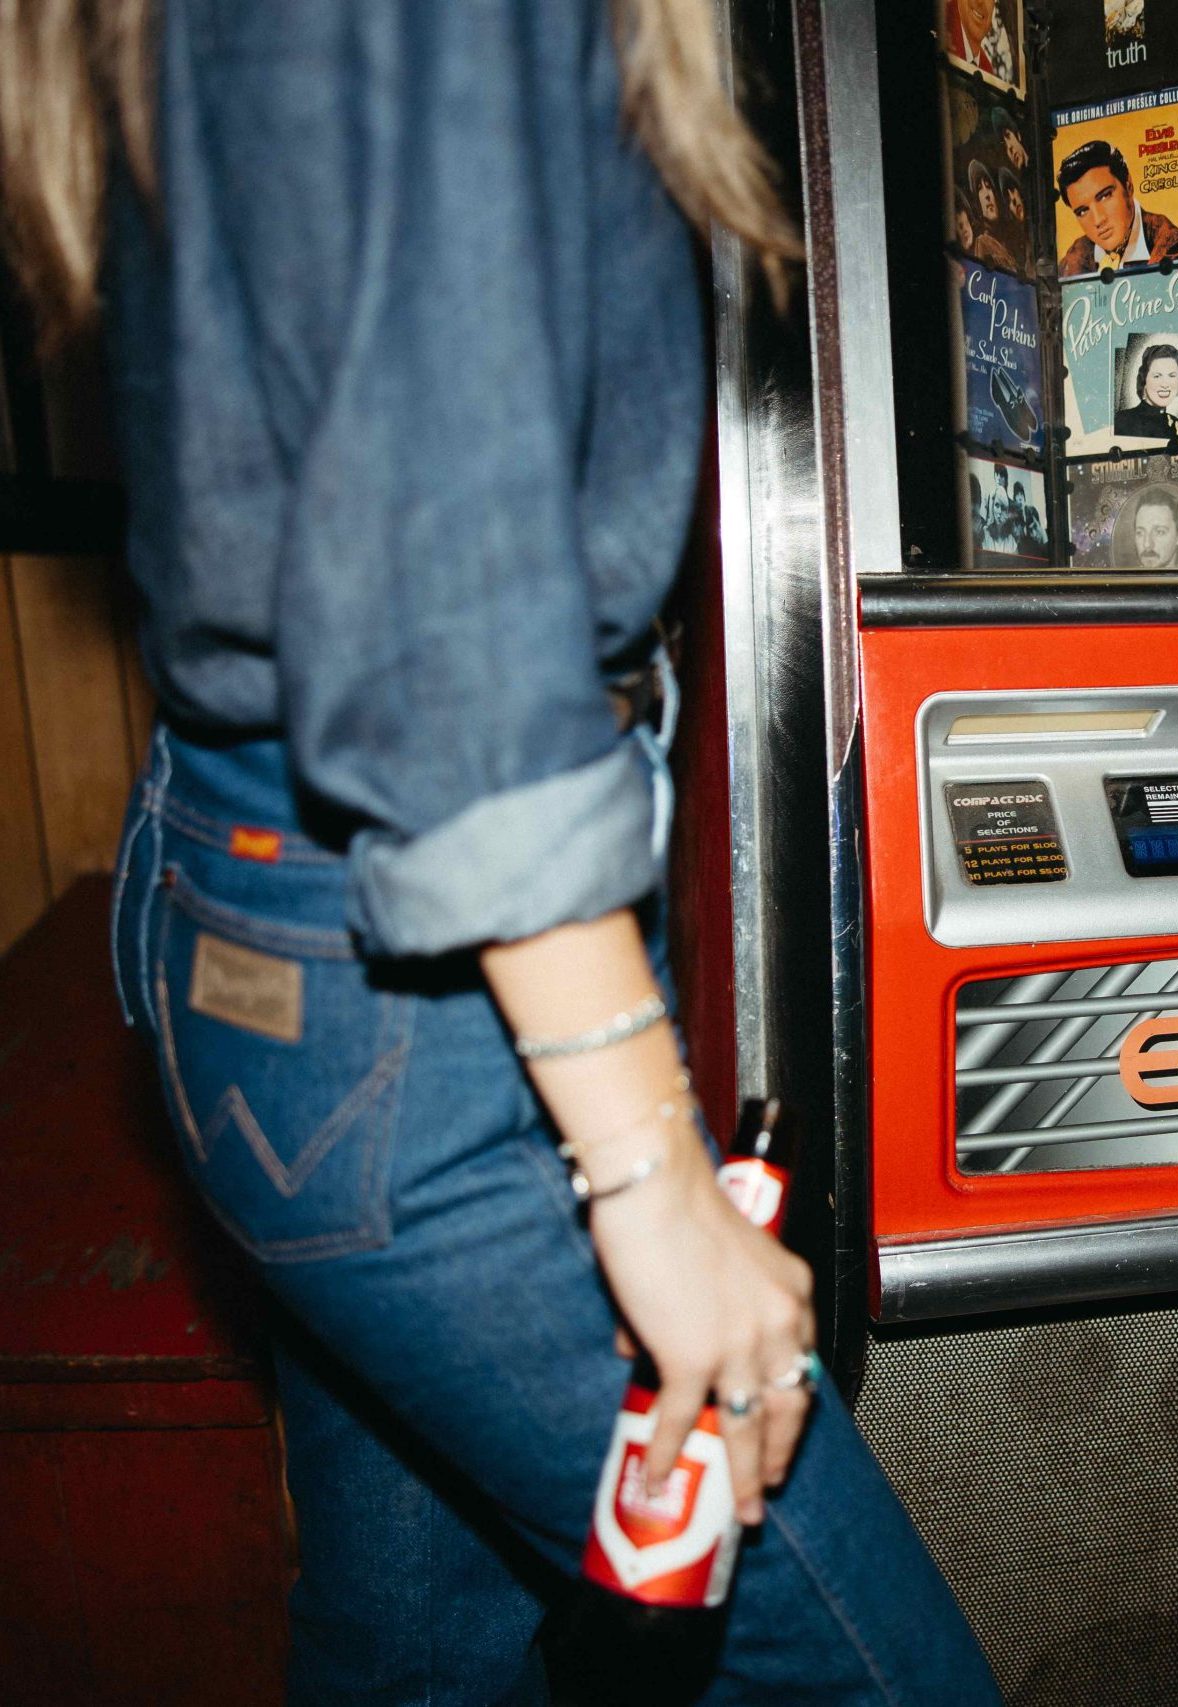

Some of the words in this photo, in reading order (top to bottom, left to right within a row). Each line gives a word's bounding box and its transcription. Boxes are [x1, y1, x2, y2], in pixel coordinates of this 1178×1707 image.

[1106, 42, 1146, 68] truth
[1056, 114, 1069, 126] THE
[1072, 106, 1104, 122] ORIGINAL
[1106, 102, 1125, 116] ELVIS
[1128, 94, 1158, 111] PRESLEY
[1145, 126, 1175, 142] ELVIS
[989, 299, 1036, 349] Perkins
[1064, 296, 1112, 361] Patsy
[1111, 279, 1162, 327] Cline
[954, 796, 1014, 807] COMPACT
[987, 810, 1017, 819] PRICE
[976, 826, 1038, 836] SELECTIONS
[964, 846, 972, 854] 5
[978, 844, 1008, 854] PLAYS
[1010, 843, 1031, 851] FOR
[1032, 842, 1057, 850] $1.00
[964, 860, 979, 869] 12
[981, 858, 1012, 866] PLAYS
[1014, 856, 1034, 864] FOR
[1036, 854, 1064, 862] $2.00
[984, 870, 1014, 878] PLAYS
[1017, 868, 1037, 876] FOR
[1039, 867, 1068, 875] $5.00
